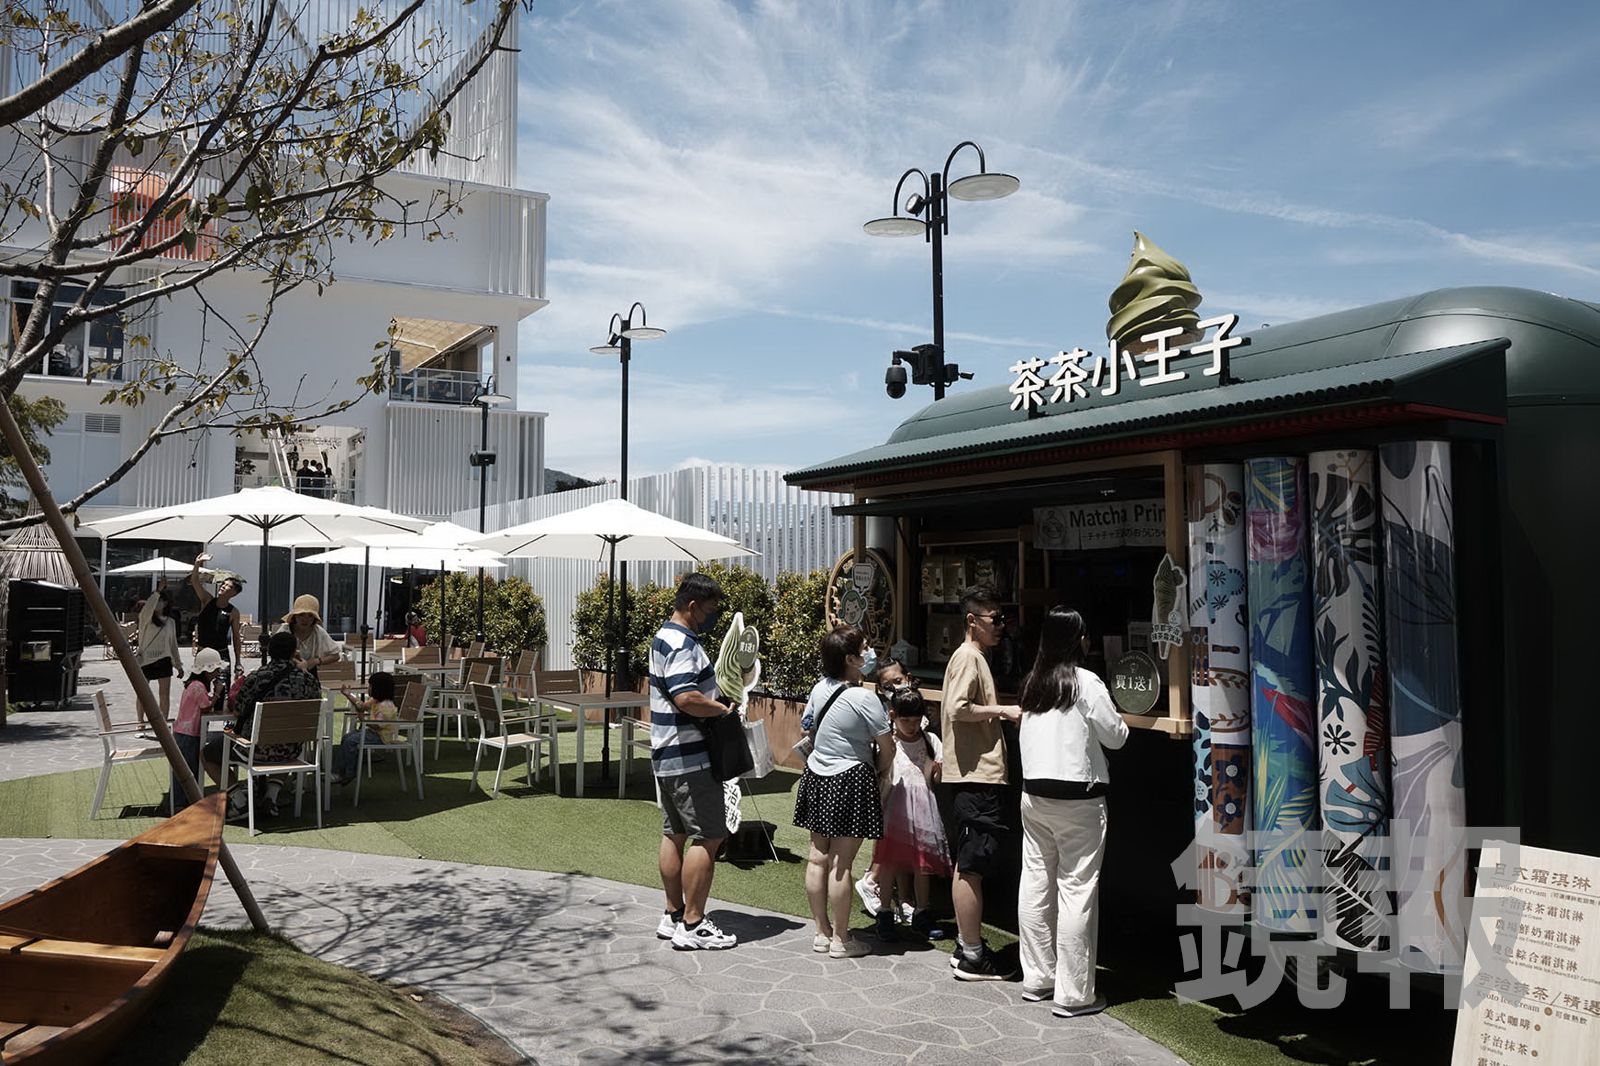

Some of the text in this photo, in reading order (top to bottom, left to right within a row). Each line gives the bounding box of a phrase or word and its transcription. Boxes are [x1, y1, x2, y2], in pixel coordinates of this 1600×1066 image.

[1009, 313, 1244, 411] 茶茶小王子
[1069, 504, 1127, 528] Matcha
[1115, 674, 1153, 692] 買1送1
[1513, 884, 1524, 893] Ice
[1524, 888, 1547, 898] Cream
[1484, 1008, 1531, 1031] 美式咖啡
[1480, 1032, 1529, 1055] 宇治抹茶
